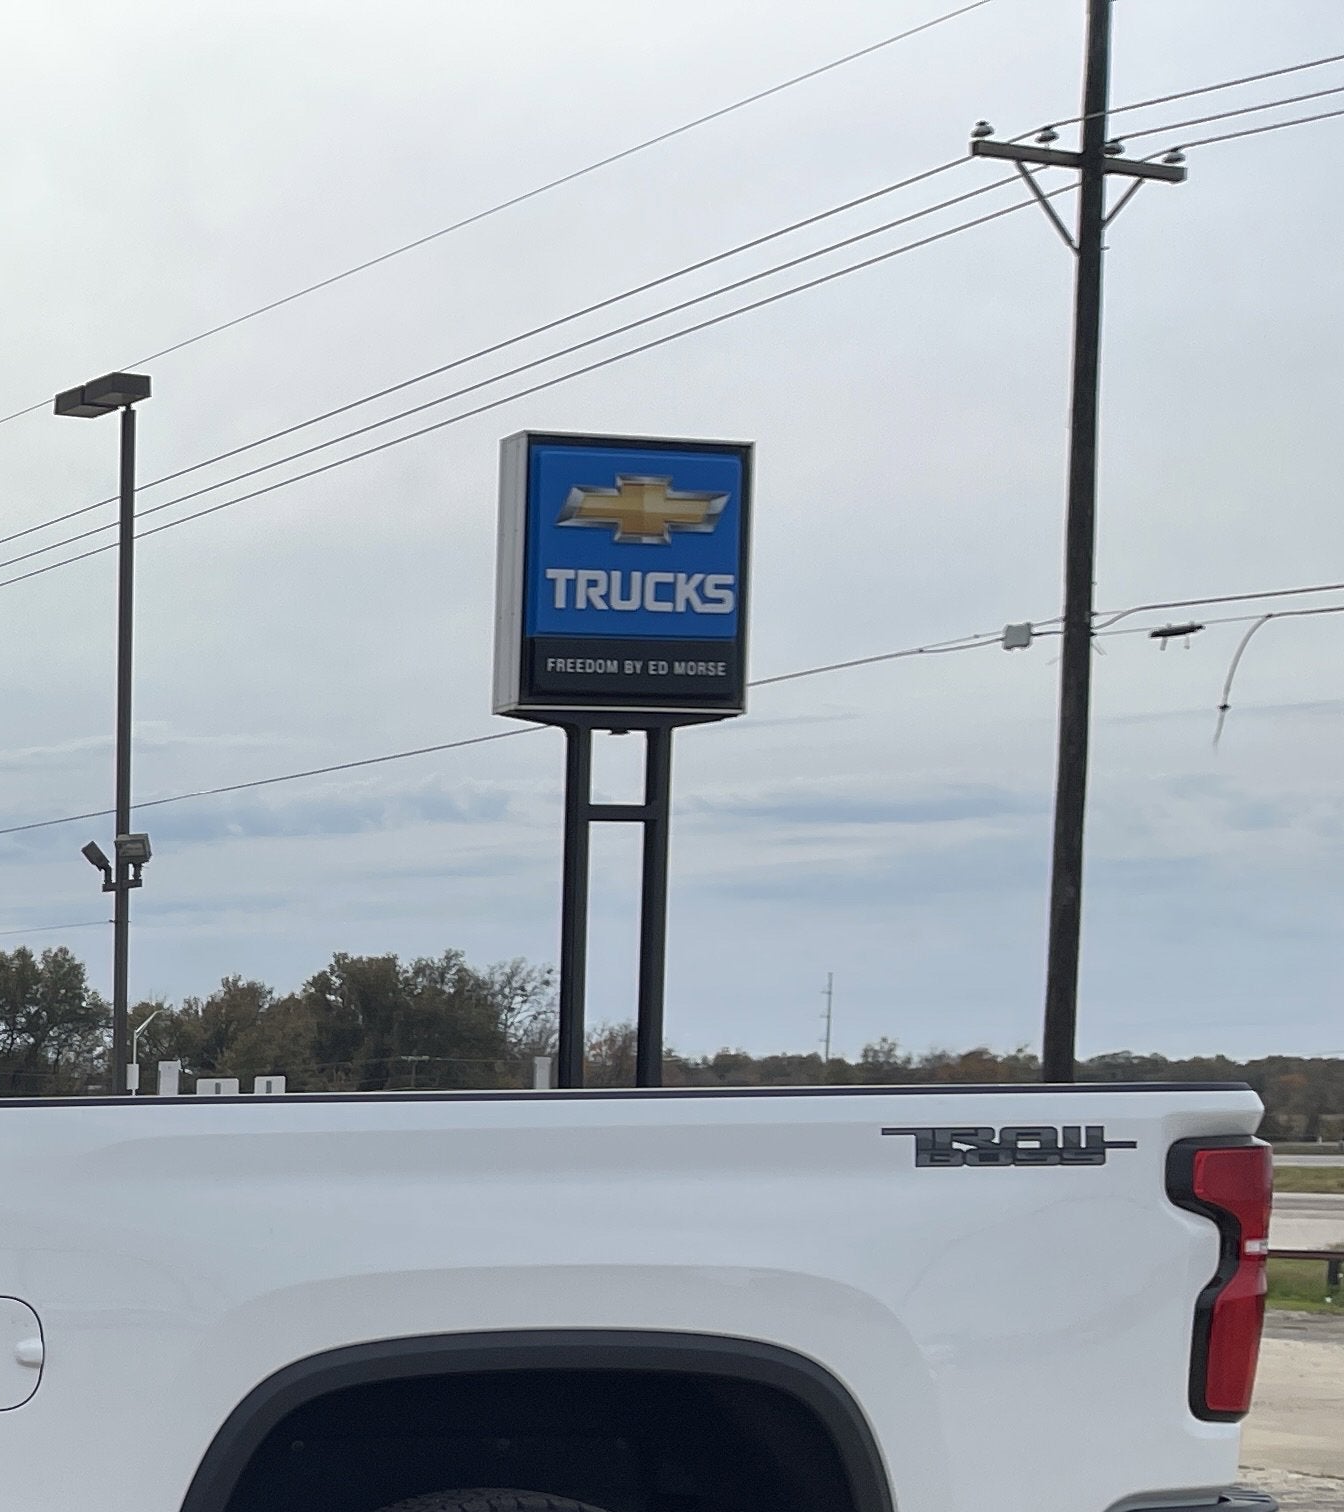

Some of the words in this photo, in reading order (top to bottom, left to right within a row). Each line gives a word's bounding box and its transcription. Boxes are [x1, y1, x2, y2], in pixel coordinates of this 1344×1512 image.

[545, 568, 736, 614] TRUCKS
[546, 657, 619, 675] FREEDOM
[623, 659, 644, 675] BY
[647, 660, 670, 676] ED
[673, 660, 727, 677] MORSE
[881, 1125, 1137, 1150] TRAIL
[915, 1148, 1107, 1168] BOSS
